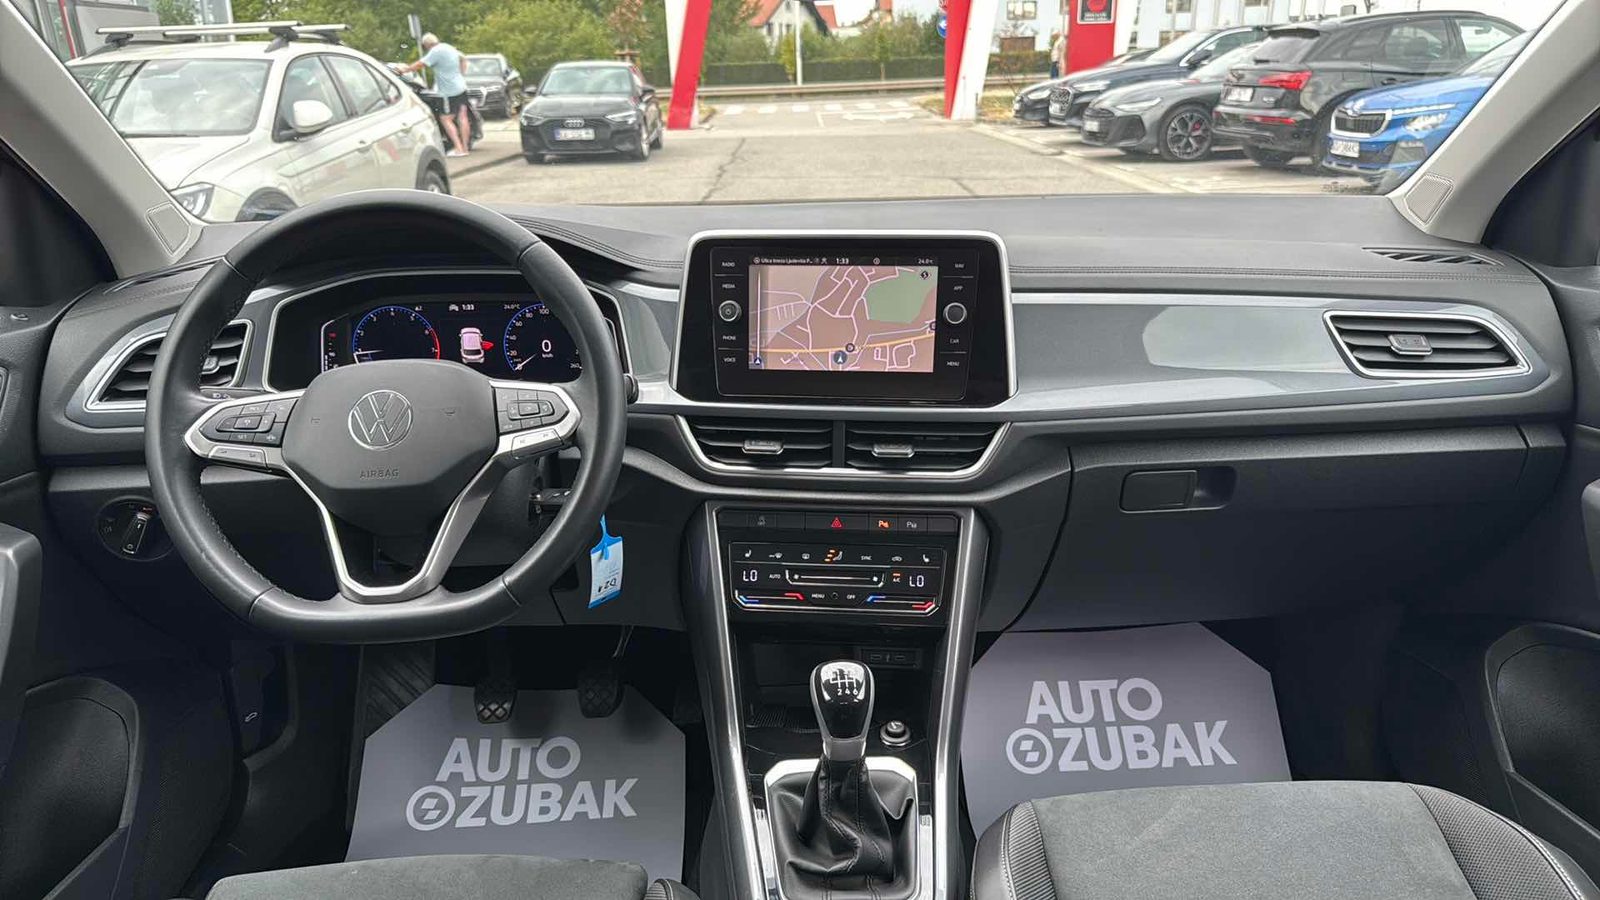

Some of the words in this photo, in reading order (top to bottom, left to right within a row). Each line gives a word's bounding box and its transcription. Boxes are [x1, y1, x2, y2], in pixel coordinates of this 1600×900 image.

[541, 339, 552, 352] 0
[359, 468, 400, 479] AIRBAG
[742, 569, 758, 582] LO
[909, 575, 925, 587] LO
[837, 688, 842, 696] 2
[1025, 677, 1163, 724] AUTO
[1052, 720, 1238, 772] ZUBAK
[435, 736, 581, 782] AUTO
[455, 778, 639, 828] ZUBAK
